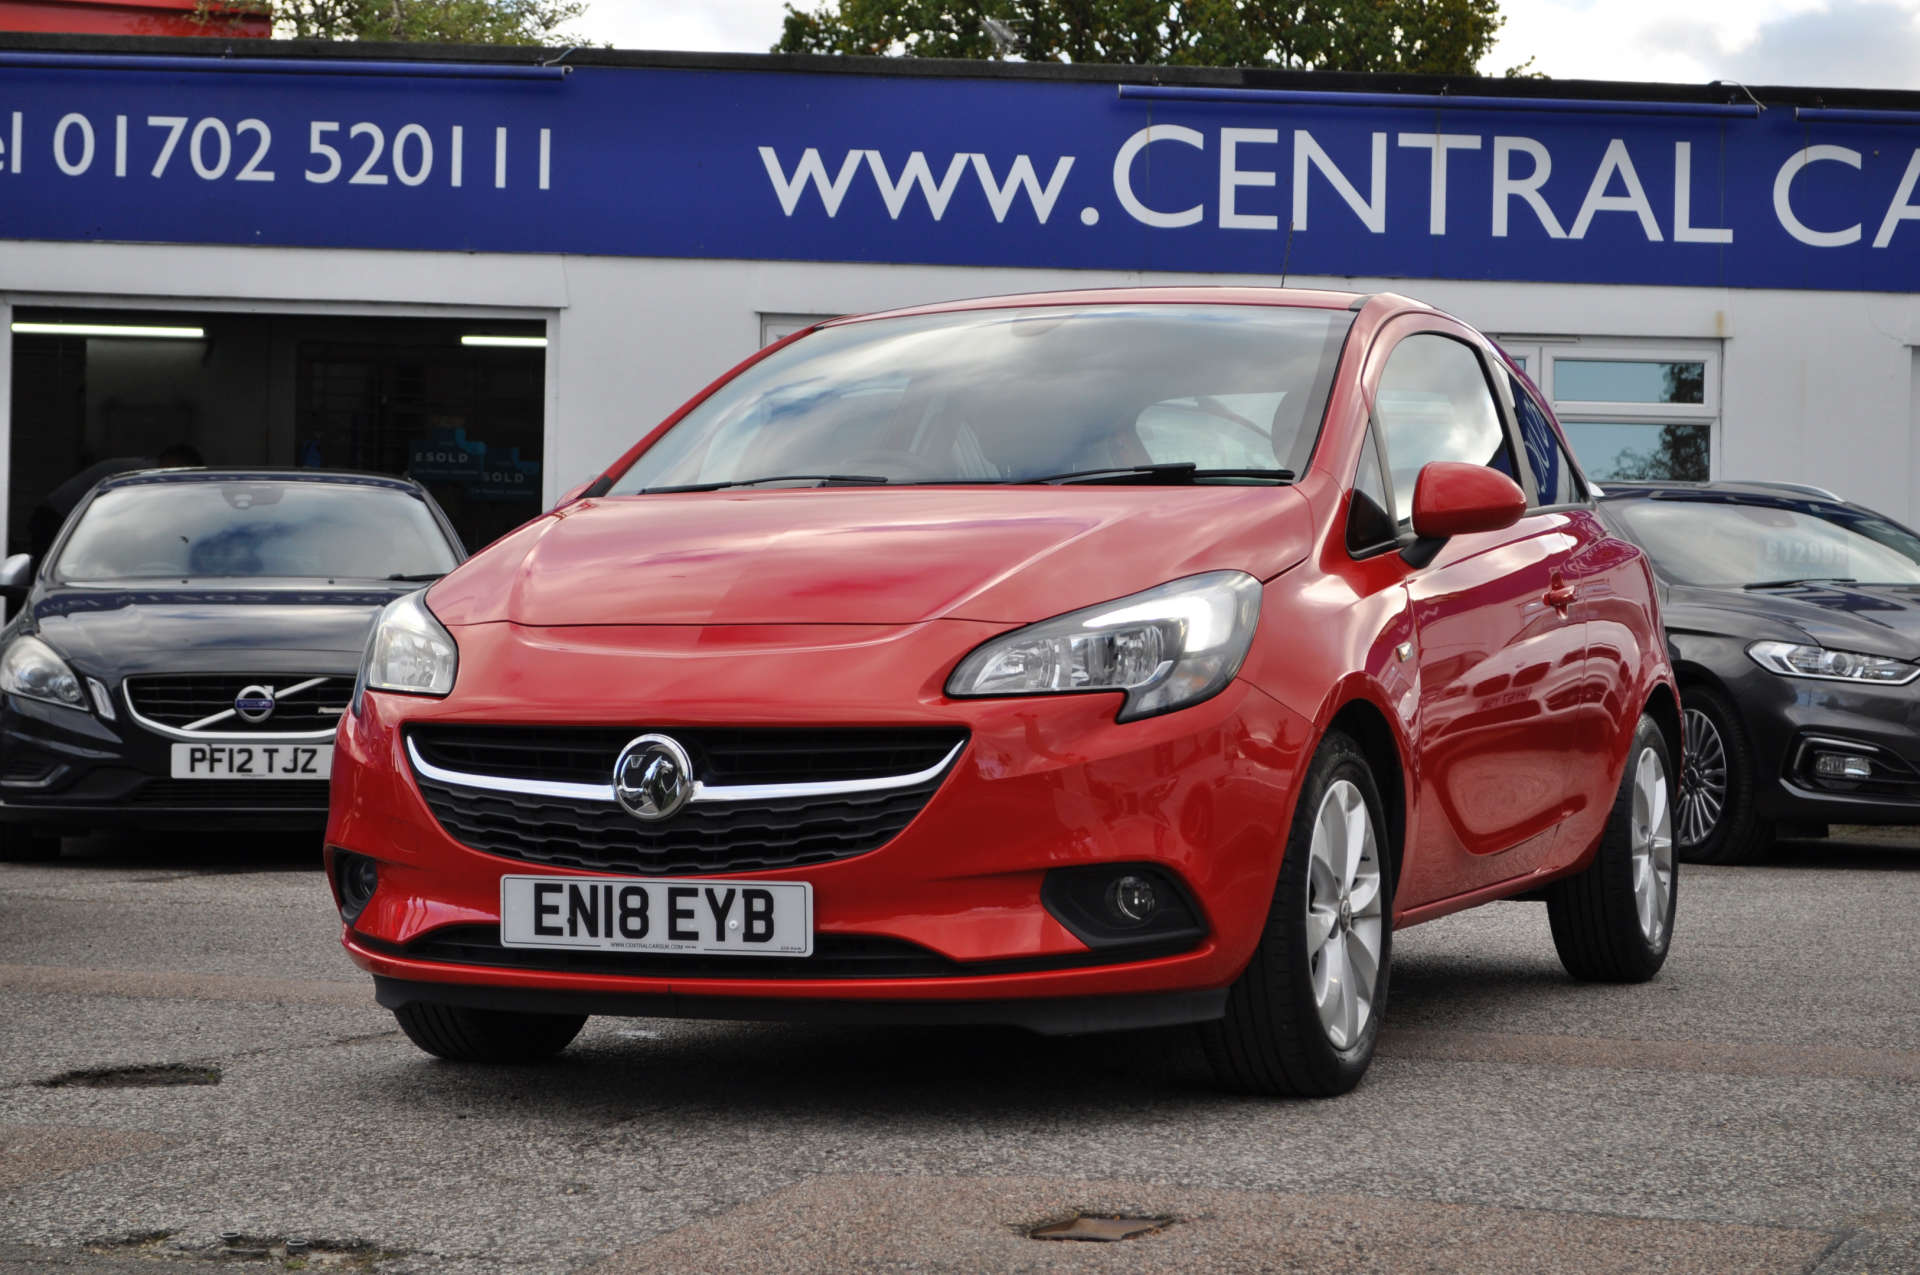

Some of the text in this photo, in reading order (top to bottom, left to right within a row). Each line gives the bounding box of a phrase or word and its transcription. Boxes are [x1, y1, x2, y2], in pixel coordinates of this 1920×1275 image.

[53, 112, 275, 181] 01702
[305, 121, 551, 190] 520111
[758, 124, 1734, 244] www.CENTRAL
[189, 747, 317, 774] PF12 TJZ
[533, 883, 775, 943] EN18 EYB
